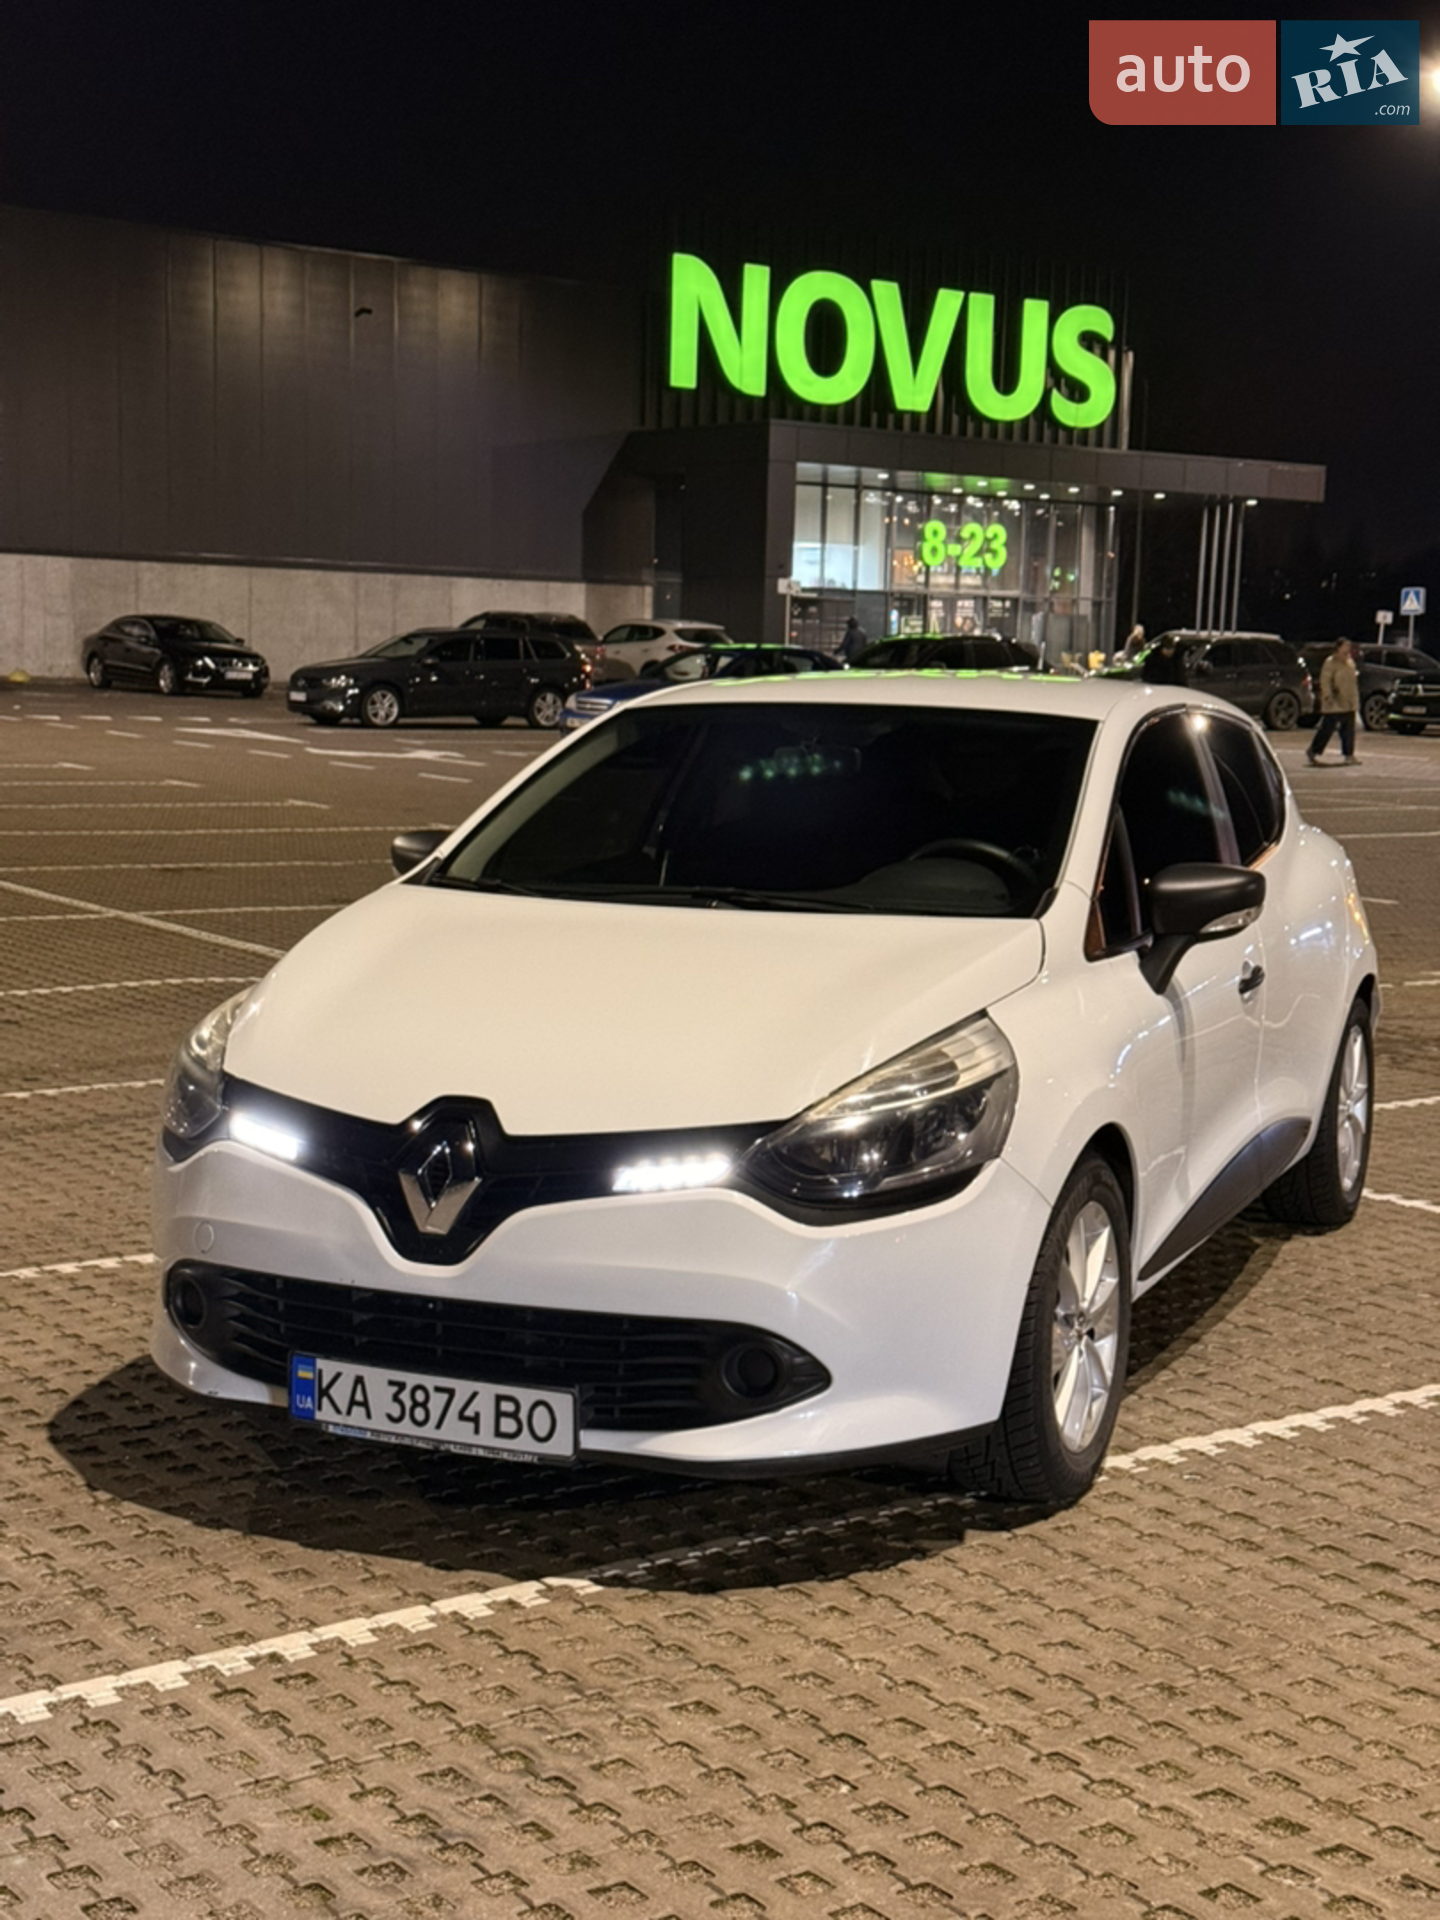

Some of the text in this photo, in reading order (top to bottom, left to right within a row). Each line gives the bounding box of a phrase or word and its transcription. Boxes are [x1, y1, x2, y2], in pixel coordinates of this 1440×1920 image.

[670, 252, 1116, 428] NOVUS
[922, 520, 1007, 569] 8-23
[296, 1394, 313, 1409] UA
[317, 1369, 372, 1420] KA
[385, 1379, 480, 1435] 3874
[494, 1393, 557, 1443] BO
